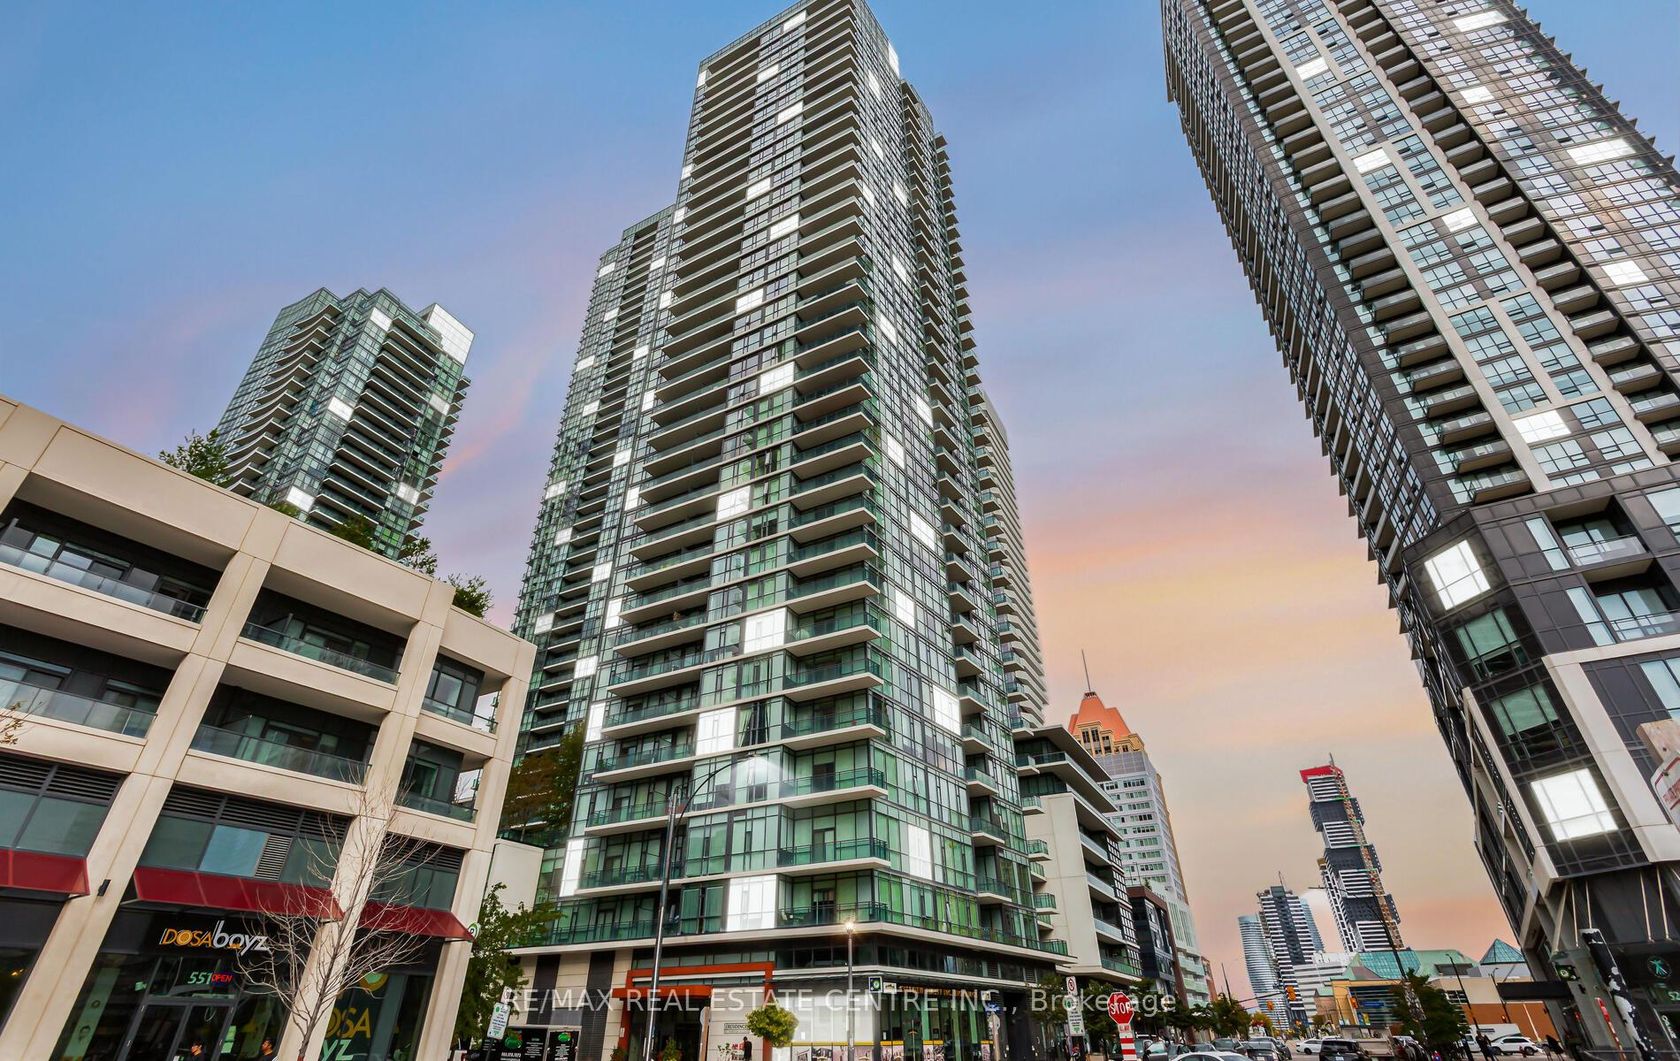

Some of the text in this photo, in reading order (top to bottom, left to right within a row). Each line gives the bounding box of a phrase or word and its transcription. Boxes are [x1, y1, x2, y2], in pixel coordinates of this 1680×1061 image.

[187, 971, 212, 985] 551
[211, 974, 233, 984] OPEN
[1110, 1001, 1132, 1015] STOP
